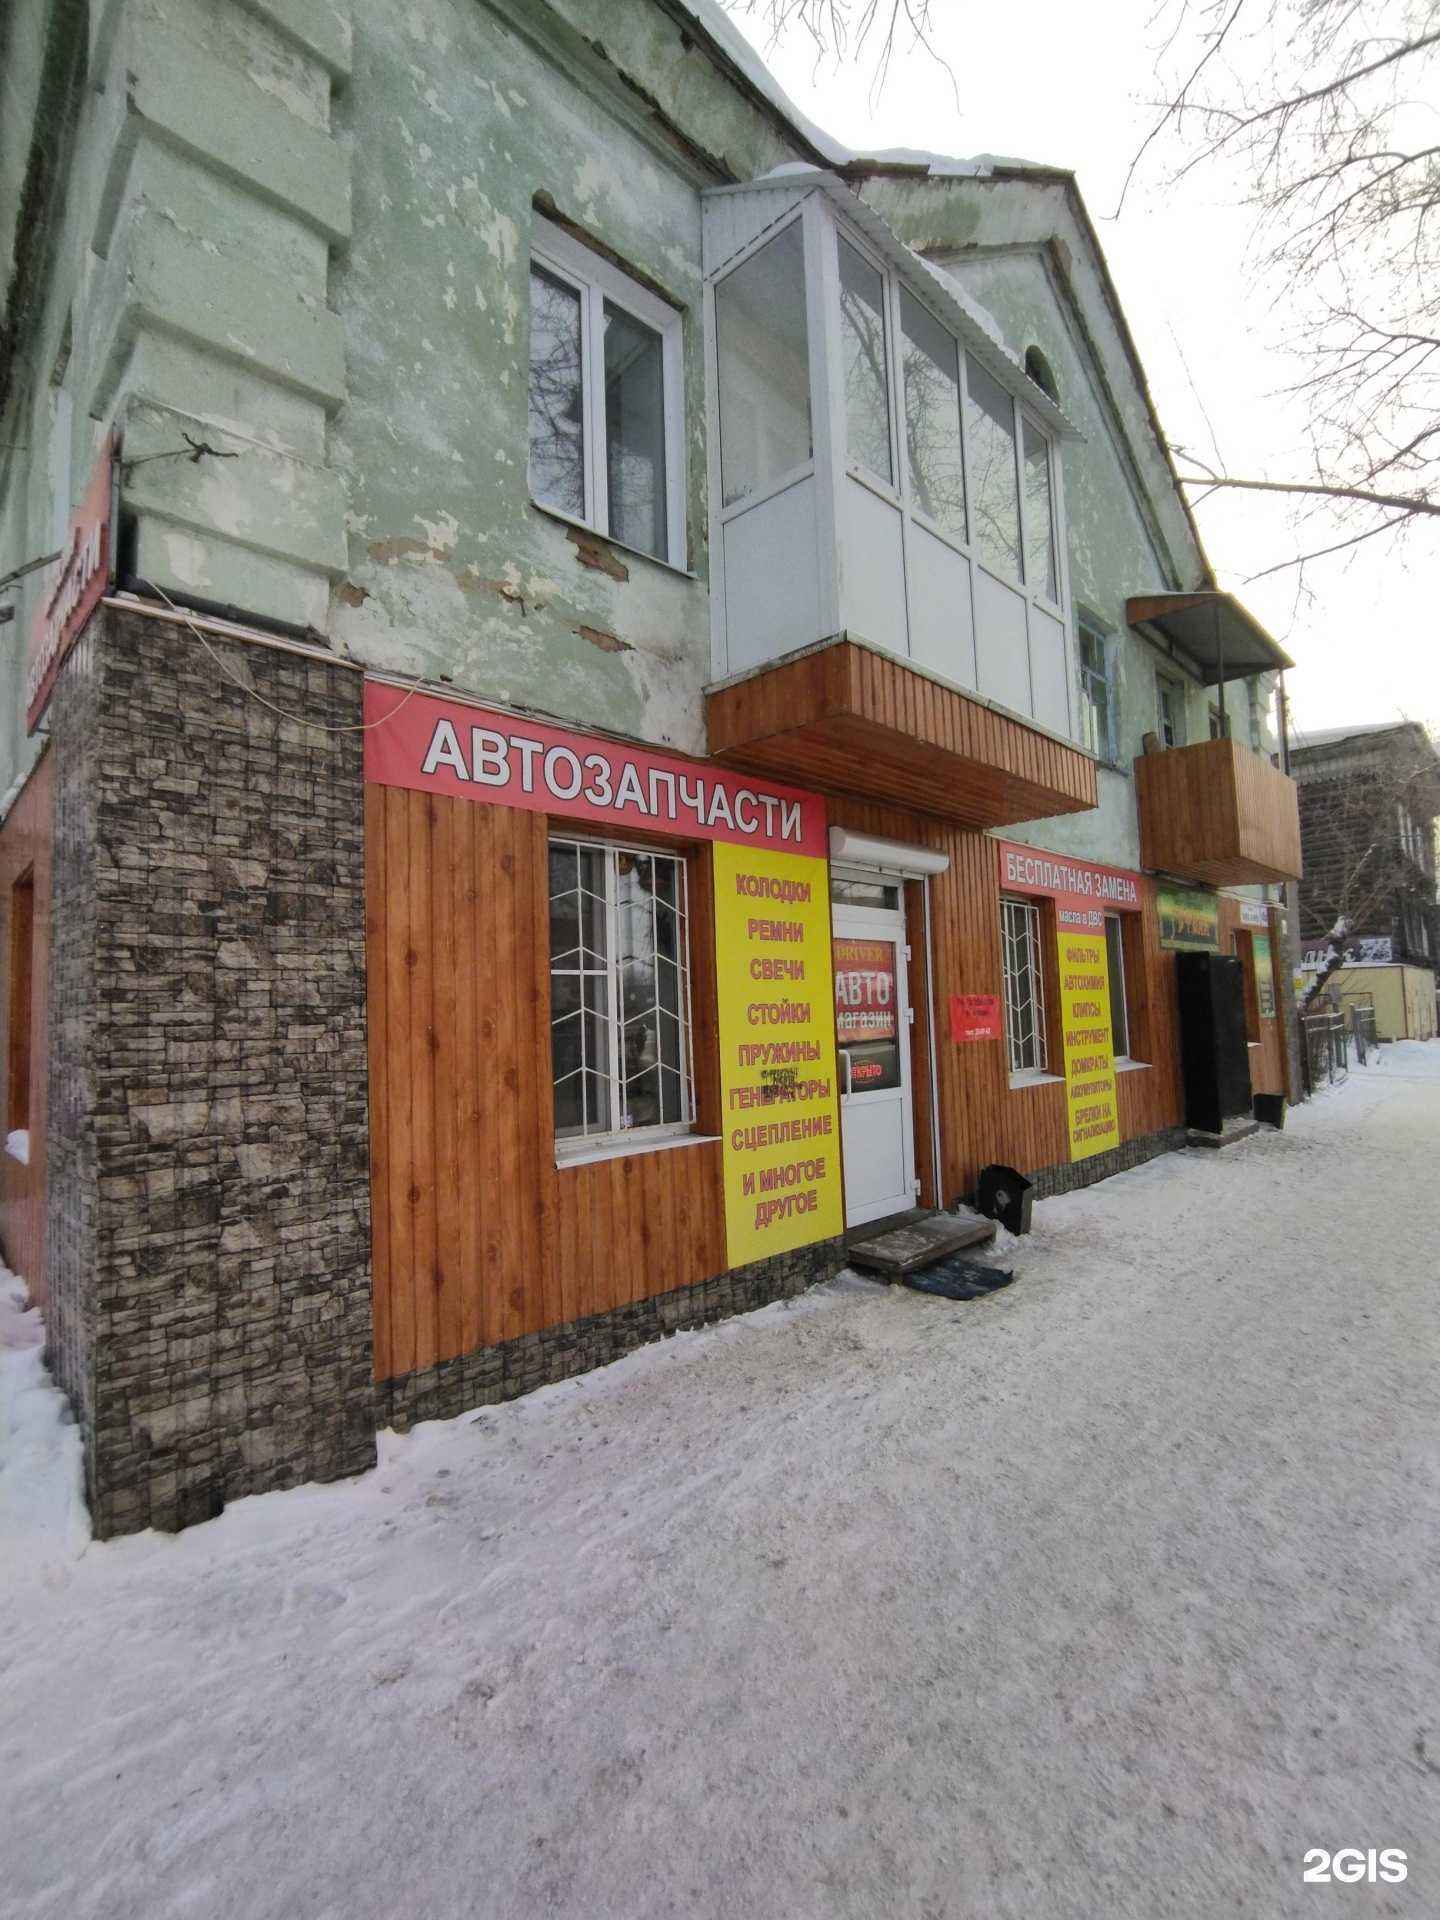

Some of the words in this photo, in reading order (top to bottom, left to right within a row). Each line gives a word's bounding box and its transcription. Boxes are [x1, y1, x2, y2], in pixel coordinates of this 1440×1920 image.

[421, 719, 802, 842] АВТОЗАПЧАСТИ
[735, 873, 811, 904] КОЛОДКИ
[1006, 852, 1093, 896] БЕСПЛАТНАЯ
[1094, 874, 1137, 902] ЗАМЕНА
[747, 918, 804, 943] РЕМНИ
[1058, 910, 1081, 925] масла
[1088, 910, 1102, 928] ДВС
[750, 958, 805, 981] СВЕЧИ
[1066, 947, 1100, 963] ФИЛЬТРЫ
[835, 970, 890, 1006] АВТО
[1063, 975, 1105, 991] АВТОХИМИЯ
[748, 998, 811, 1025] СТОЙКИ
[738, 1039, 820, 1066] ПРУЖИНЫ
[729, 1078, 831, 1110] ГЕНЕРАТОРЫ
[731, 1115, 832, 1151] СЦЕПЛЕНИЕ
[743, 1173, 755, 1196] И
[760, 1157, 826, 1193] МНОГОЕ
[755, 1190, 818, 1230] ДРУГОЕ
